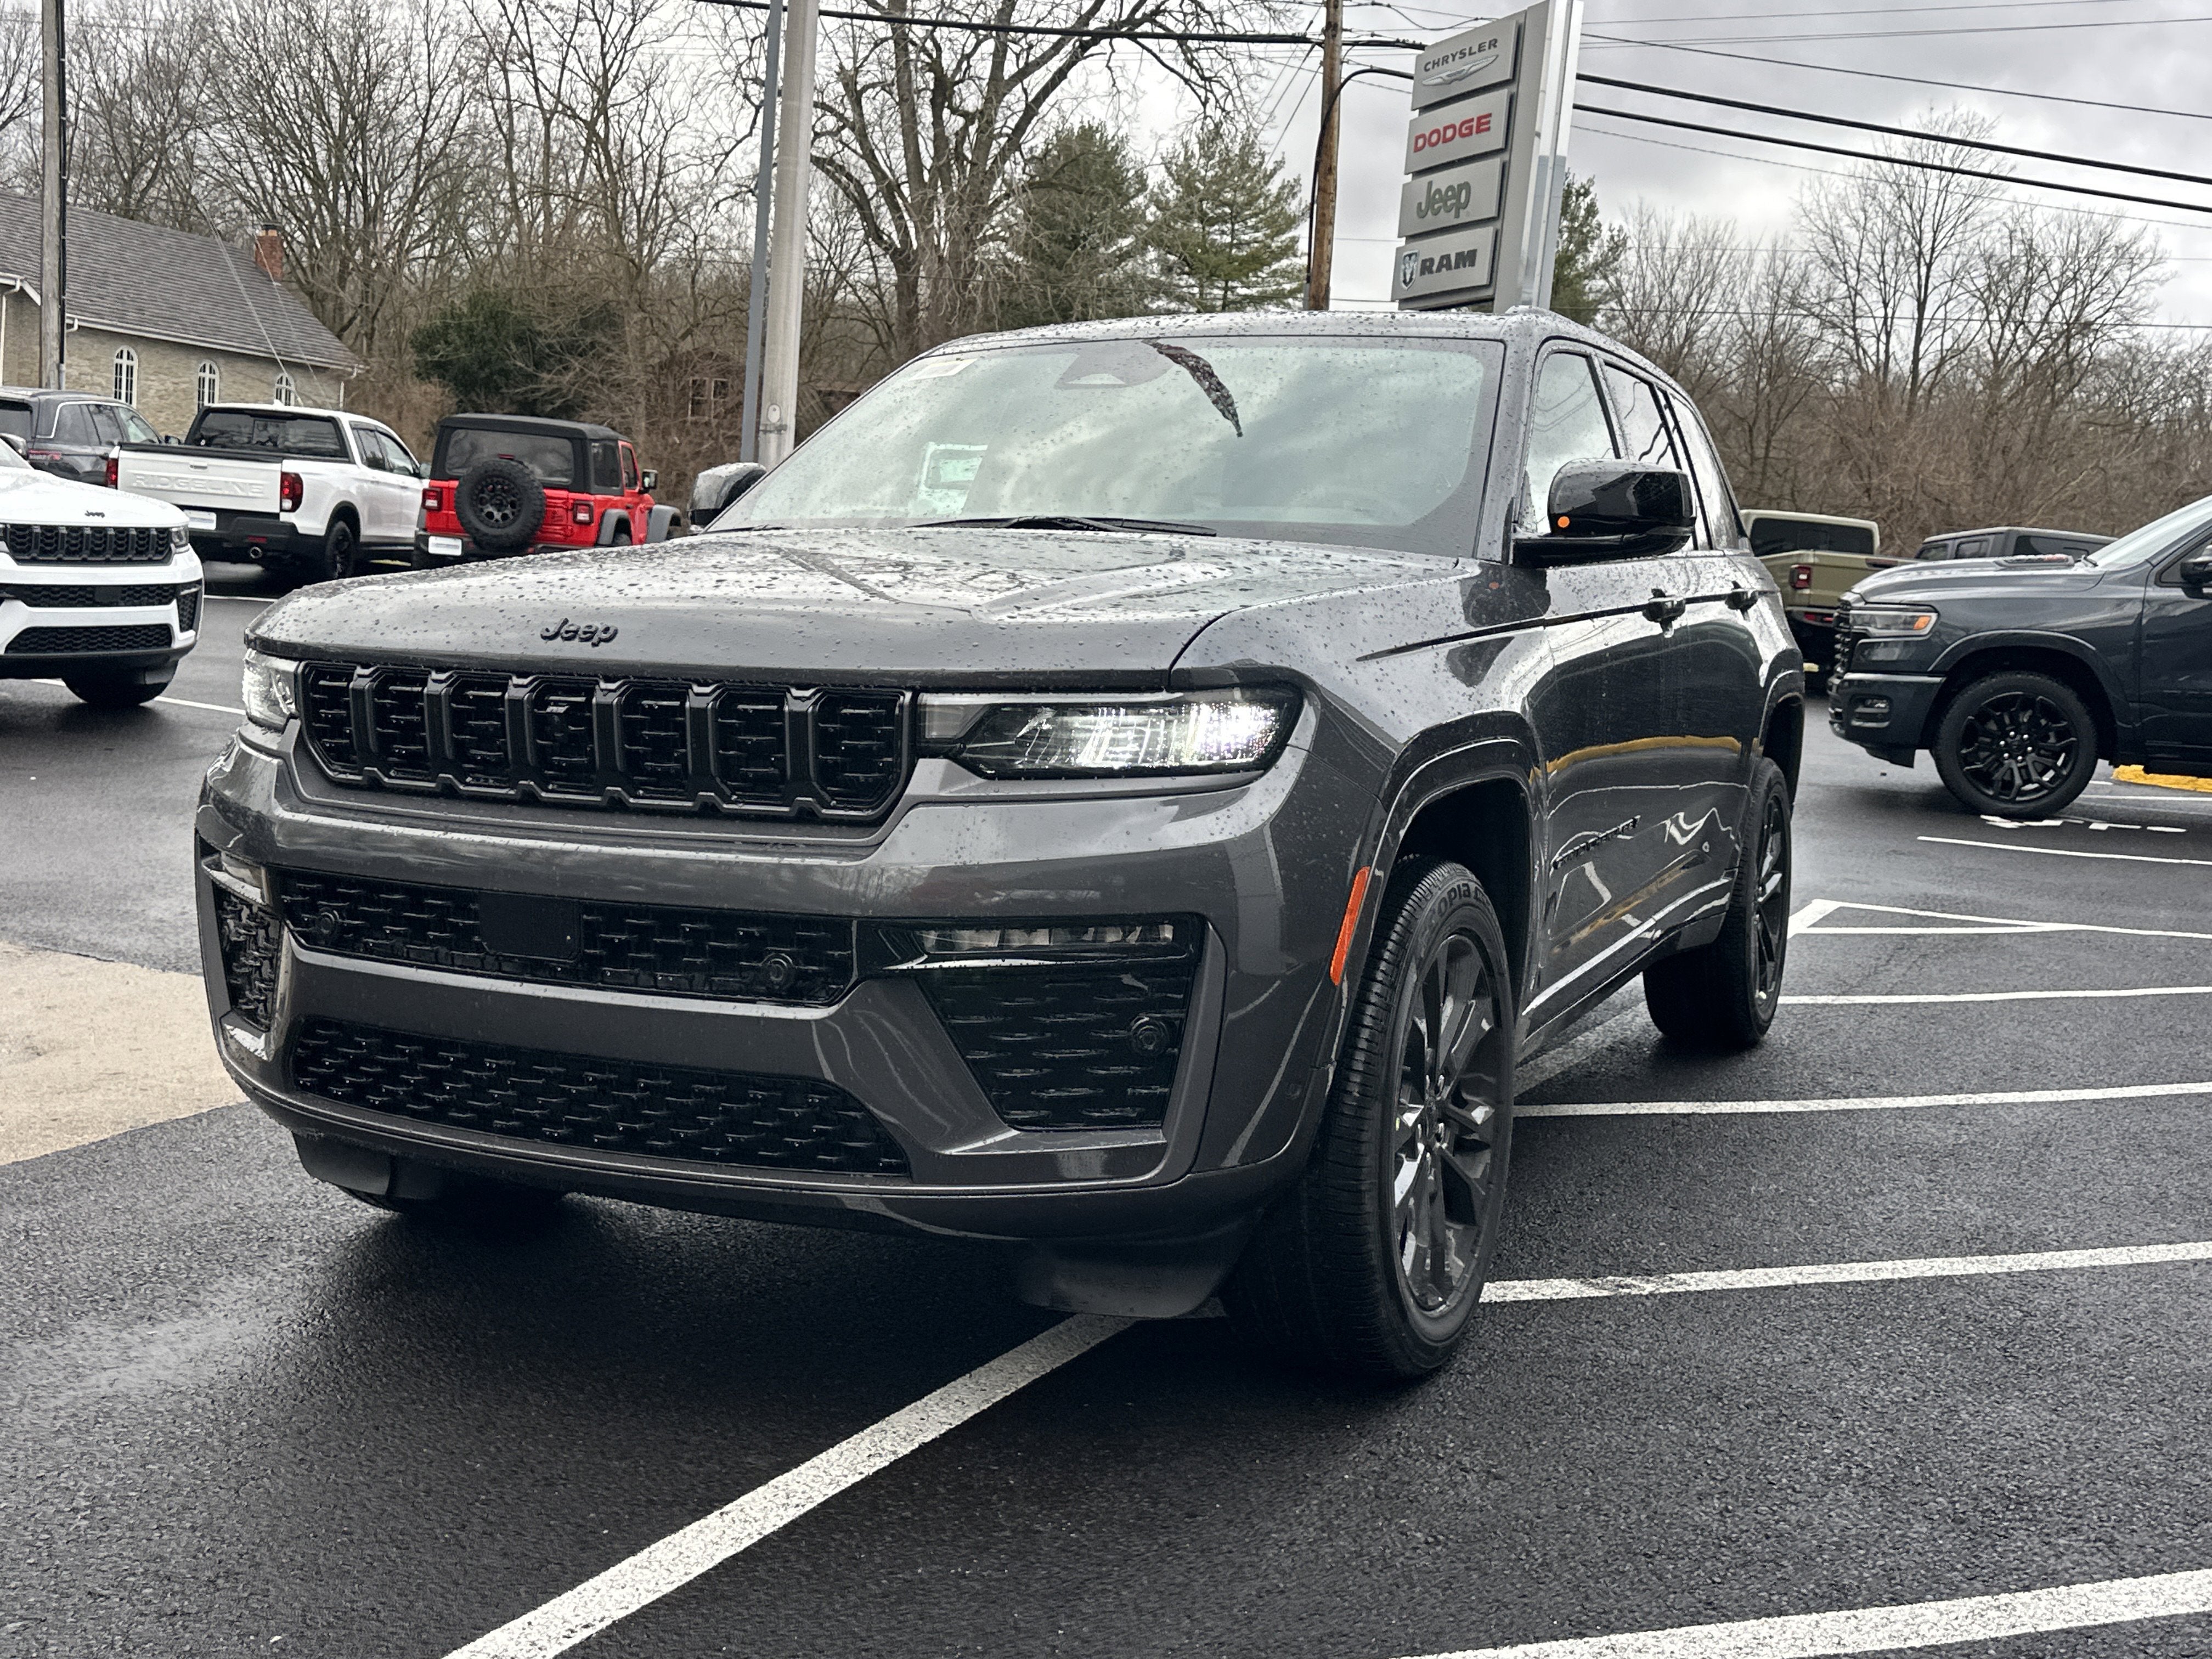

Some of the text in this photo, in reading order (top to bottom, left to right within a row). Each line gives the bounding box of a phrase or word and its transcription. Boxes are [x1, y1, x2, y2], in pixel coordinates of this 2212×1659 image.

[1424, 38, 1498, 72] CHRYSLER
[1413, 112, 1492, 153] DODGE
[1417, 180, 1471, 219] Jeep
[1420, 249, 1477, 276] RAM
[131, 474, 264, 496] RIDGELINE
[540, 618, 618, 647] Jeep
